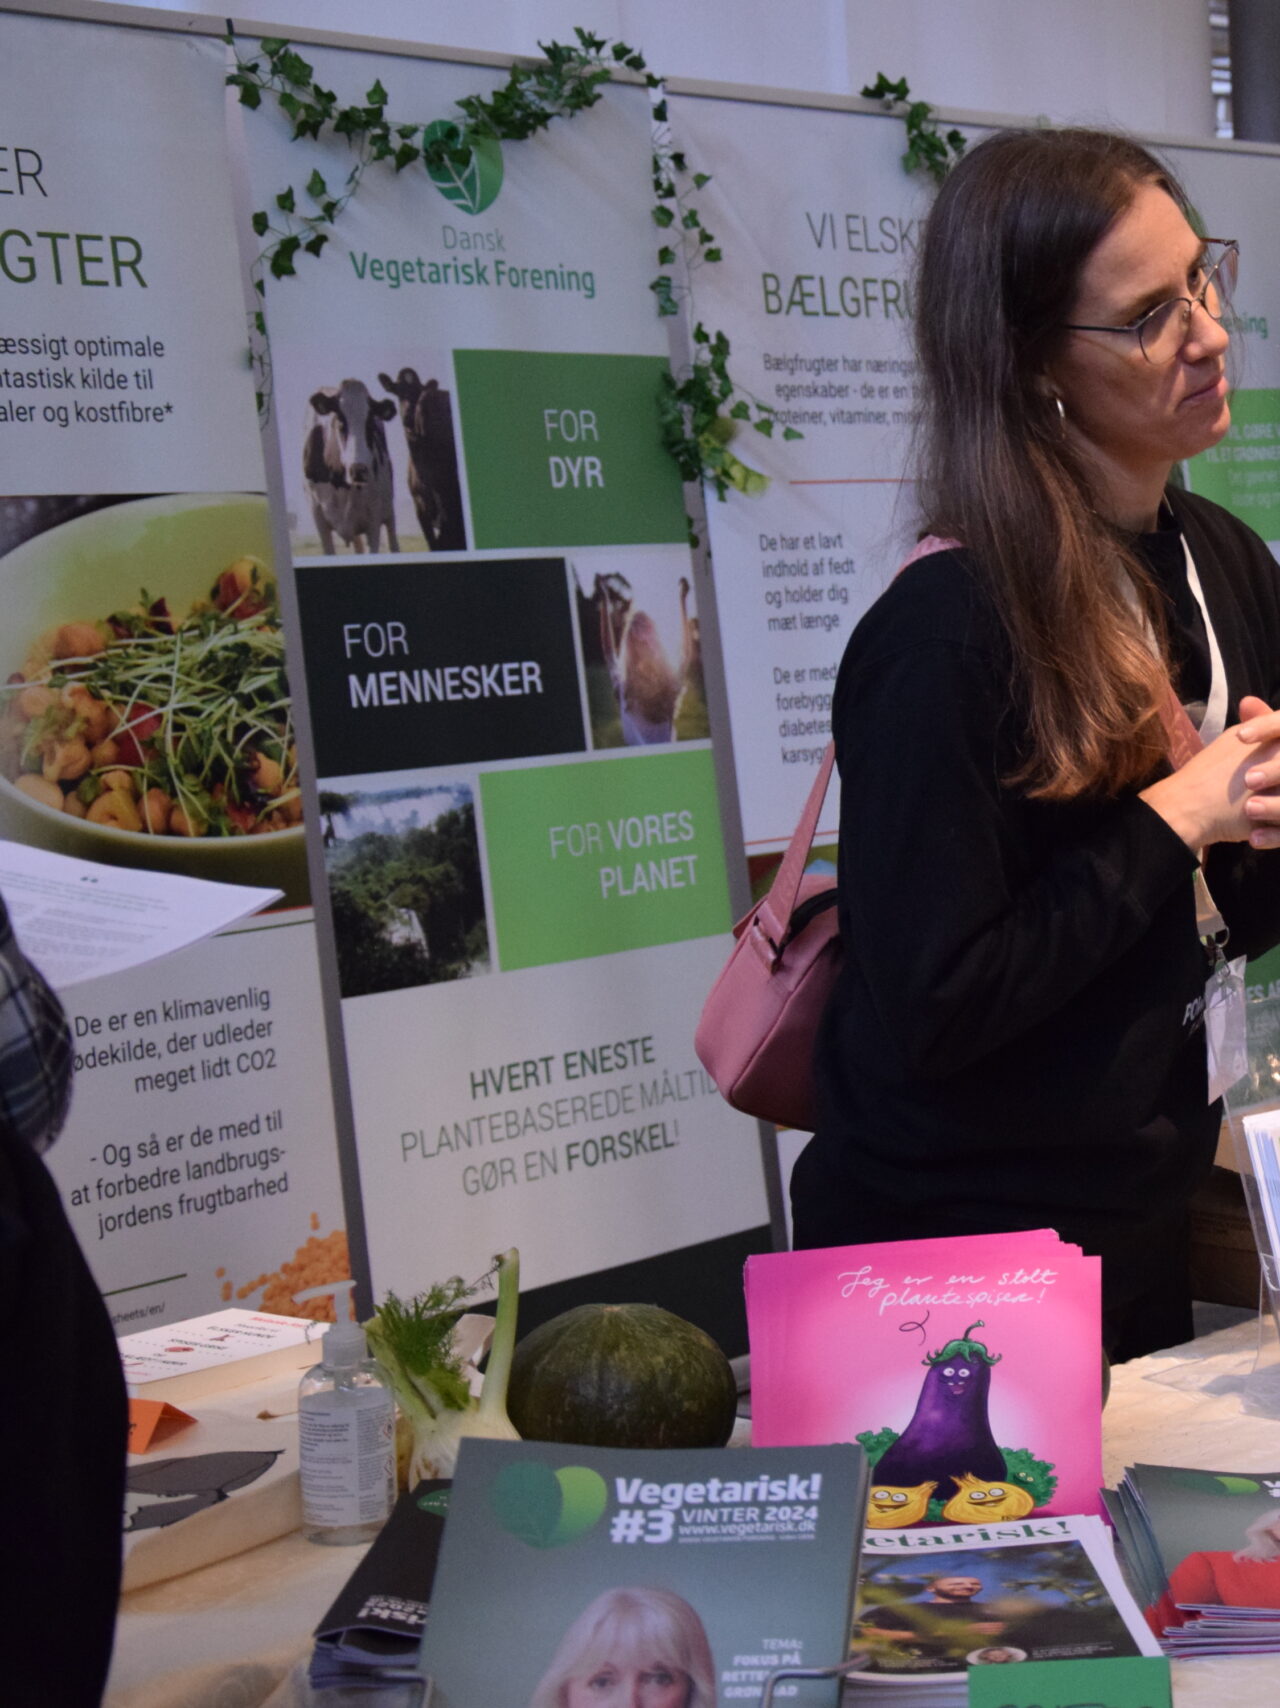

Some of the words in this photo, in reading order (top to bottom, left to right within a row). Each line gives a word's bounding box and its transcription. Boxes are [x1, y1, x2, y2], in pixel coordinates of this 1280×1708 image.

[442, 225, 506, 252] Dansk
[805, 211, 837, 250] VI
[349, 251, 490, 289] Vegetarisk
[494, 260, 596, 299] Forening
[74, 335, 165, 361] optimale
[842, 354, 863, 373] har
[80, 367, 128, 389] kilde
[133, 368, 154, 390] til
[43, 405, 69, 427] og
[543, 408, 599, 442] FOR
[549, 456, 604, 489] DYR
[759, 533, 777, 552] De
[780, 534, 800, 551] har
[803, 534, 816, 550] et
[818, 532, 843, 550] lavt
[762, 559, 809, 578] indhold
[812, 559, 826, 576] af
[828, 558, 855, 575] fedt
[765, 590, 782, 608] og
[785, 586, 824, 604] holder
[827, 585, 848, 604] dig
[343, 621, 409, 659] FOR
[768, 616, 797, 632] mæt
[800, 613, 840, 632] længe
[348, 661, 544, 709] MENNESKER
[773, 666, 790, 685] De
[794, 668, 806, 683] er
[548, 823, 603, 860] FOR
[607, 810, 694, 851] VORES
[600, 855, 699, 899] PLANET
[74, 1015, 102, 1037] De
[108, 1011, 127, 1031] er
[133, 1006, 158, 1028] en
[162, 987, 271, 1024] klimavenlig
[73, 1038, 162, 1072] ødekilde,
[166, 1032, 198, 1055] der
[202, 1019, 273, 1050] udleder
[134, 1065, 196, 1093] meget
[201, 1057, 232, 1081] lidt
[236, 1048, 278, 1074] CO2
[469, 1055, 555, 1101] HVERT
[562, 1035, 656, 1082] ENESTE
[102, 1143, 131, 1168] Og
[137, 1133, 160, 1159] så
[165, 1132, 185, 1152] er
[190, 1125, 213, 1148] de
[219, 1113, 261, 1143] med
[264, 1109, 283, 1132] til
[400, 1083, 637, 1163] PLANTEBASEREDE
[70, 1184, 92, 1207] at
[96, 1167, 181, 1201] forbedre
[185, 1147, 286, 1183] landbrugs-
[462, 1157, 518, 1197] GØR
[524, 1146, 558, 1182] EN
[565, 1119, 681, 1172] FORSKEL!
[97, 1202, 173, 1240] jordens
[177, 1172, 289, 1217] frugtbarhed
[837, 1265, 890, 1299] Jeg
[902, 1274, 934, 1286] er
[945, 1274, 986, 1286] en
[997, 1268, 1059, 1286] stolt
[615, 1473, 823, 1511] Vegetarisk!
[609, 1508, 676, 1544] #3
[681, 1507, 760, 1524] VINTER
[764, 1505, 819, 1522] 2024
[678, 1519, 816, 1538] www.vegetarisk.dk
[862, 1521, 1072, 1548] etarisk!
